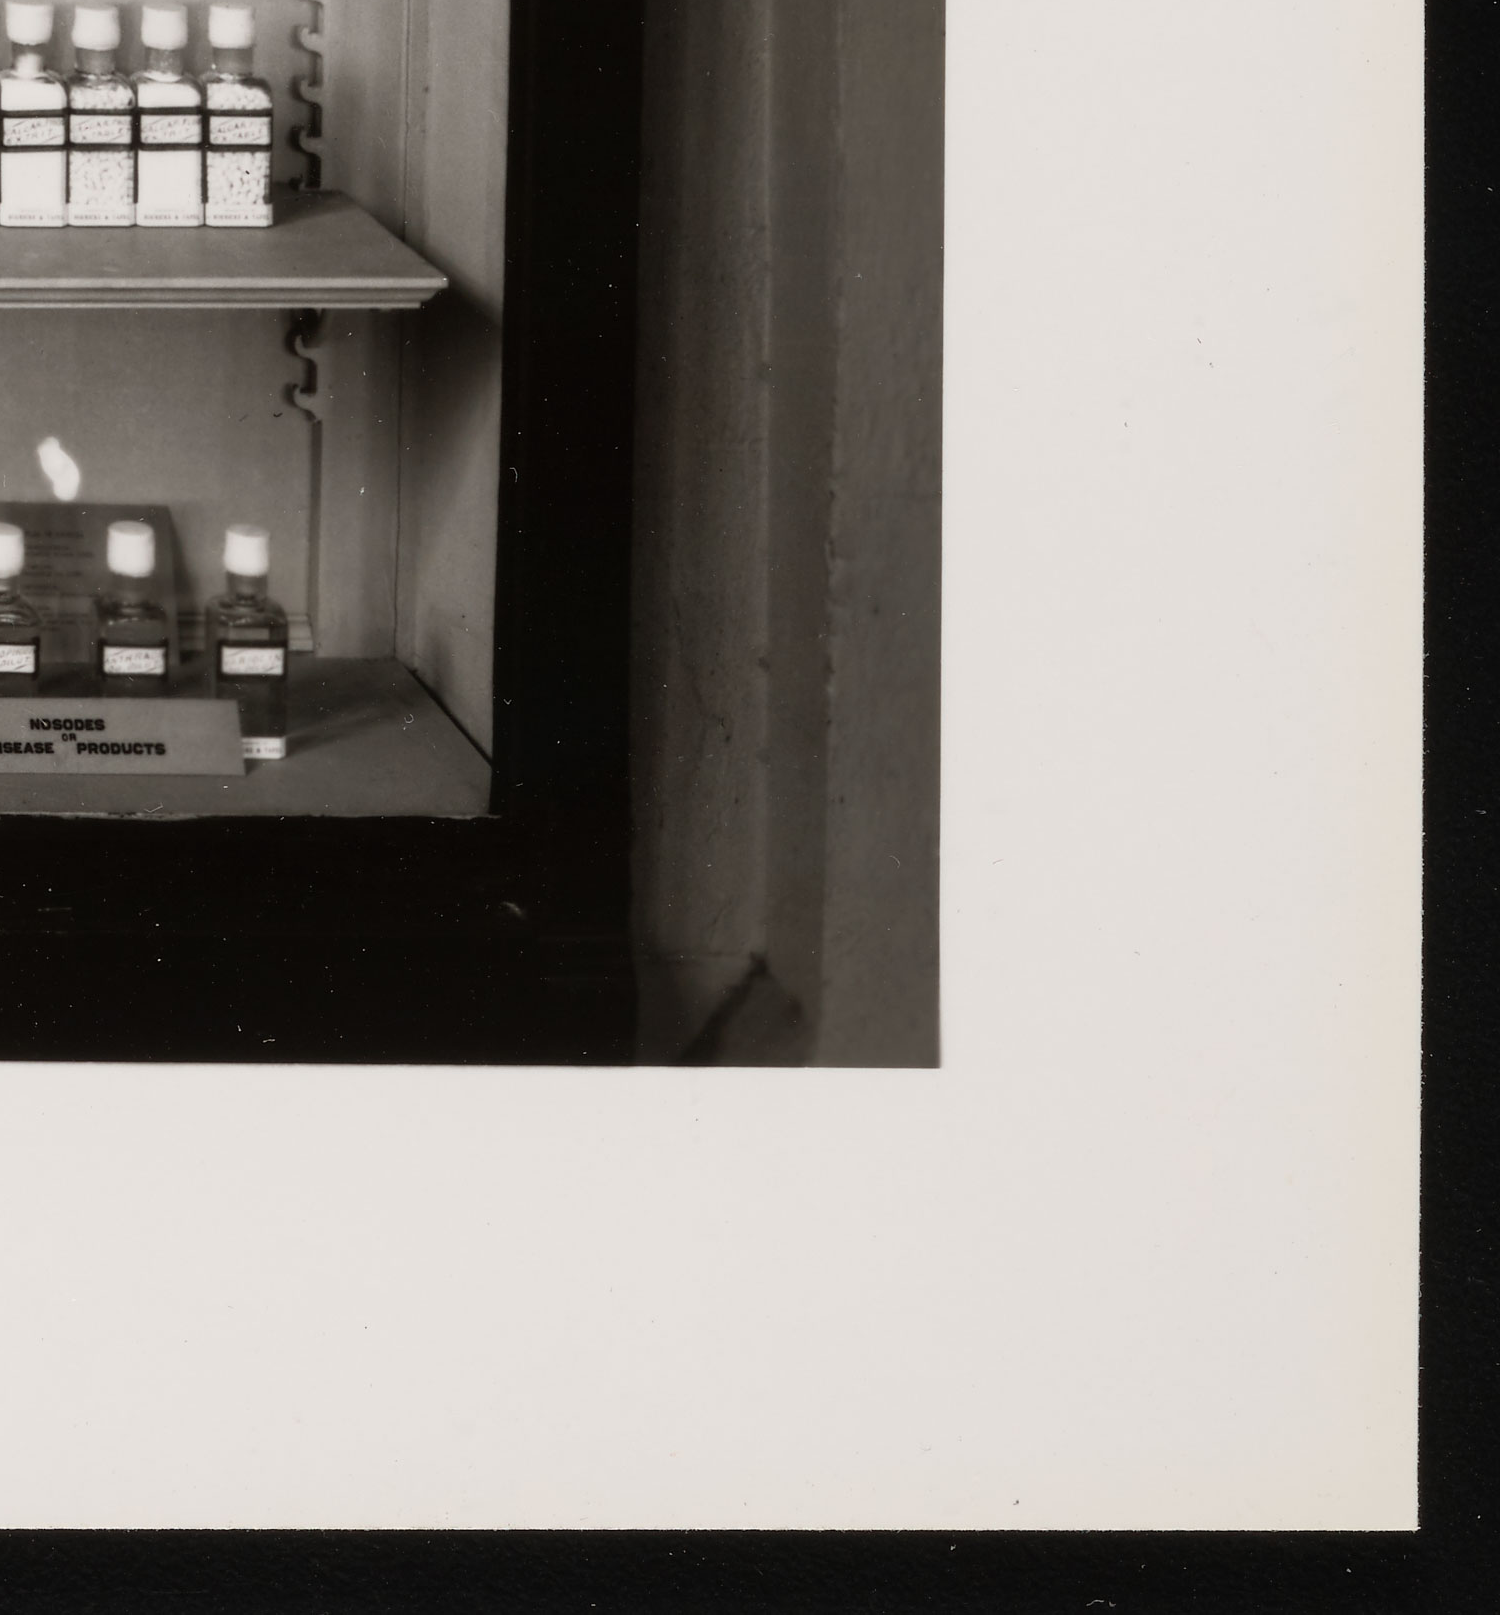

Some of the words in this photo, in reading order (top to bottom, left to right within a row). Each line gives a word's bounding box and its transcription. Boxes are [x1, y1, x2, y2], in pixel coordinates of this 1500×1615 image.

[29, 718, 106, 732] NOSODES
[62, 733, 77, 743] OR
[76, 742, 167, 756] PRODUCTS
